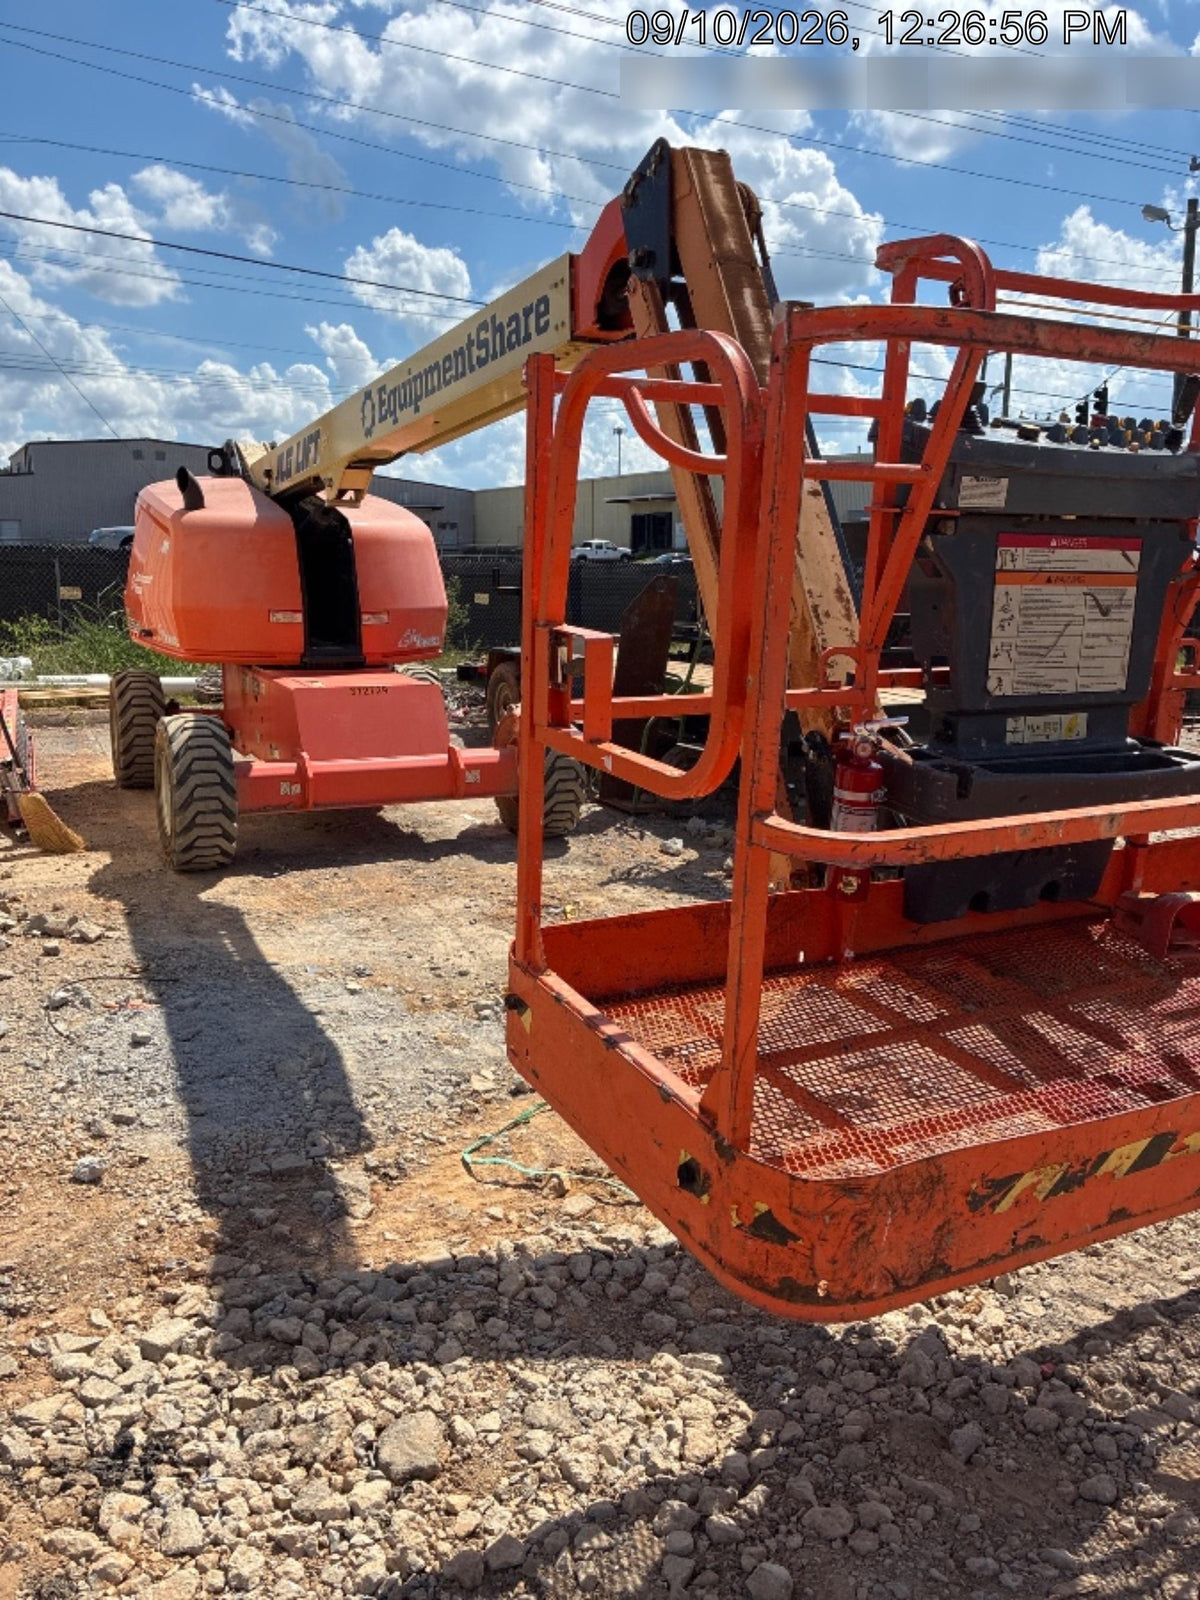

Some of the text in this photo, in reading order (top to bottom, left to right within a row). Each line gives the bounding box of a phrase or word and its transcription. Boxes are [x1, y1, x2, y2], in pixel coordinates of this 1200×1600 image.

[377, 294, 550, 426] EquipmentShare
[275, 428, 321, 485] JLG LIFT
